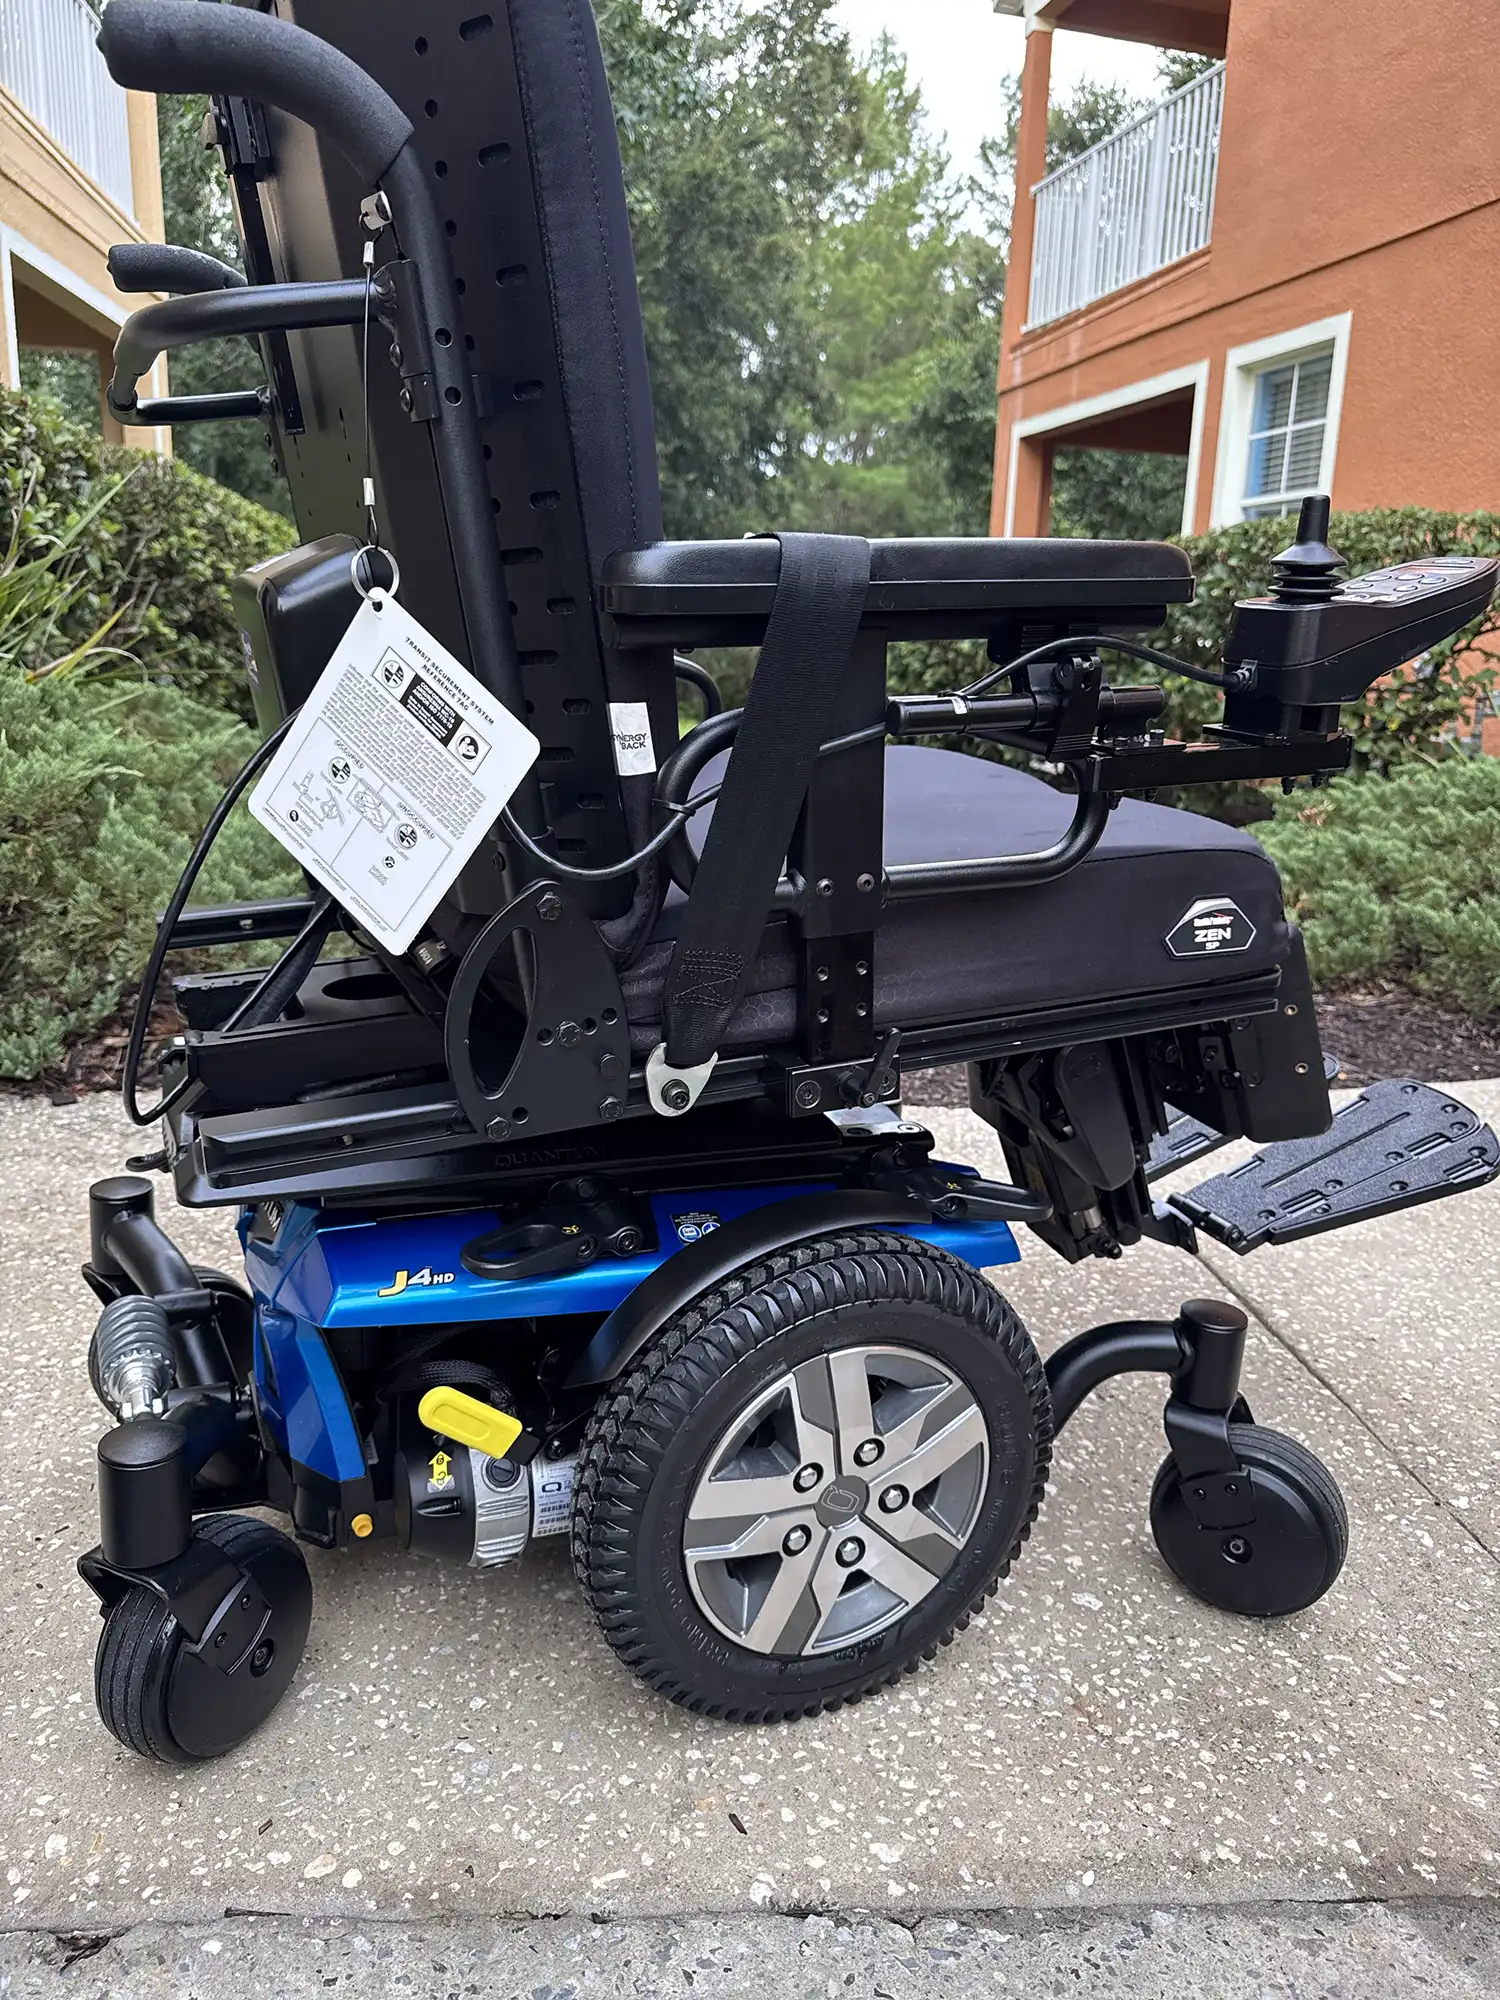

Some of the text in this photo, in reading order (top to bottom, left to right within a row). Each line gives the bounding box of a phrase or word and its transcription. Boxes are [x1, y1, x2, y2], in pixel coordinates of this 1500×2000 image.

[405, 636, 494, 725] TRANSIT SECUREMENT SYSTEM
[422, 664, 469, 711] REFERENCE TAG
[420, 681, 445, 707] CONFORMS
[443, 704, 455, 717] WITH
[335, 738, 364, 769] OCCUPIED
[621, 741, 647, 750] BACK
[398, 801, 435, 840] UNOCCUPIED
[1194, 927, 1232, 943] ZEN
[1205, 942, 1220, 950] SP
